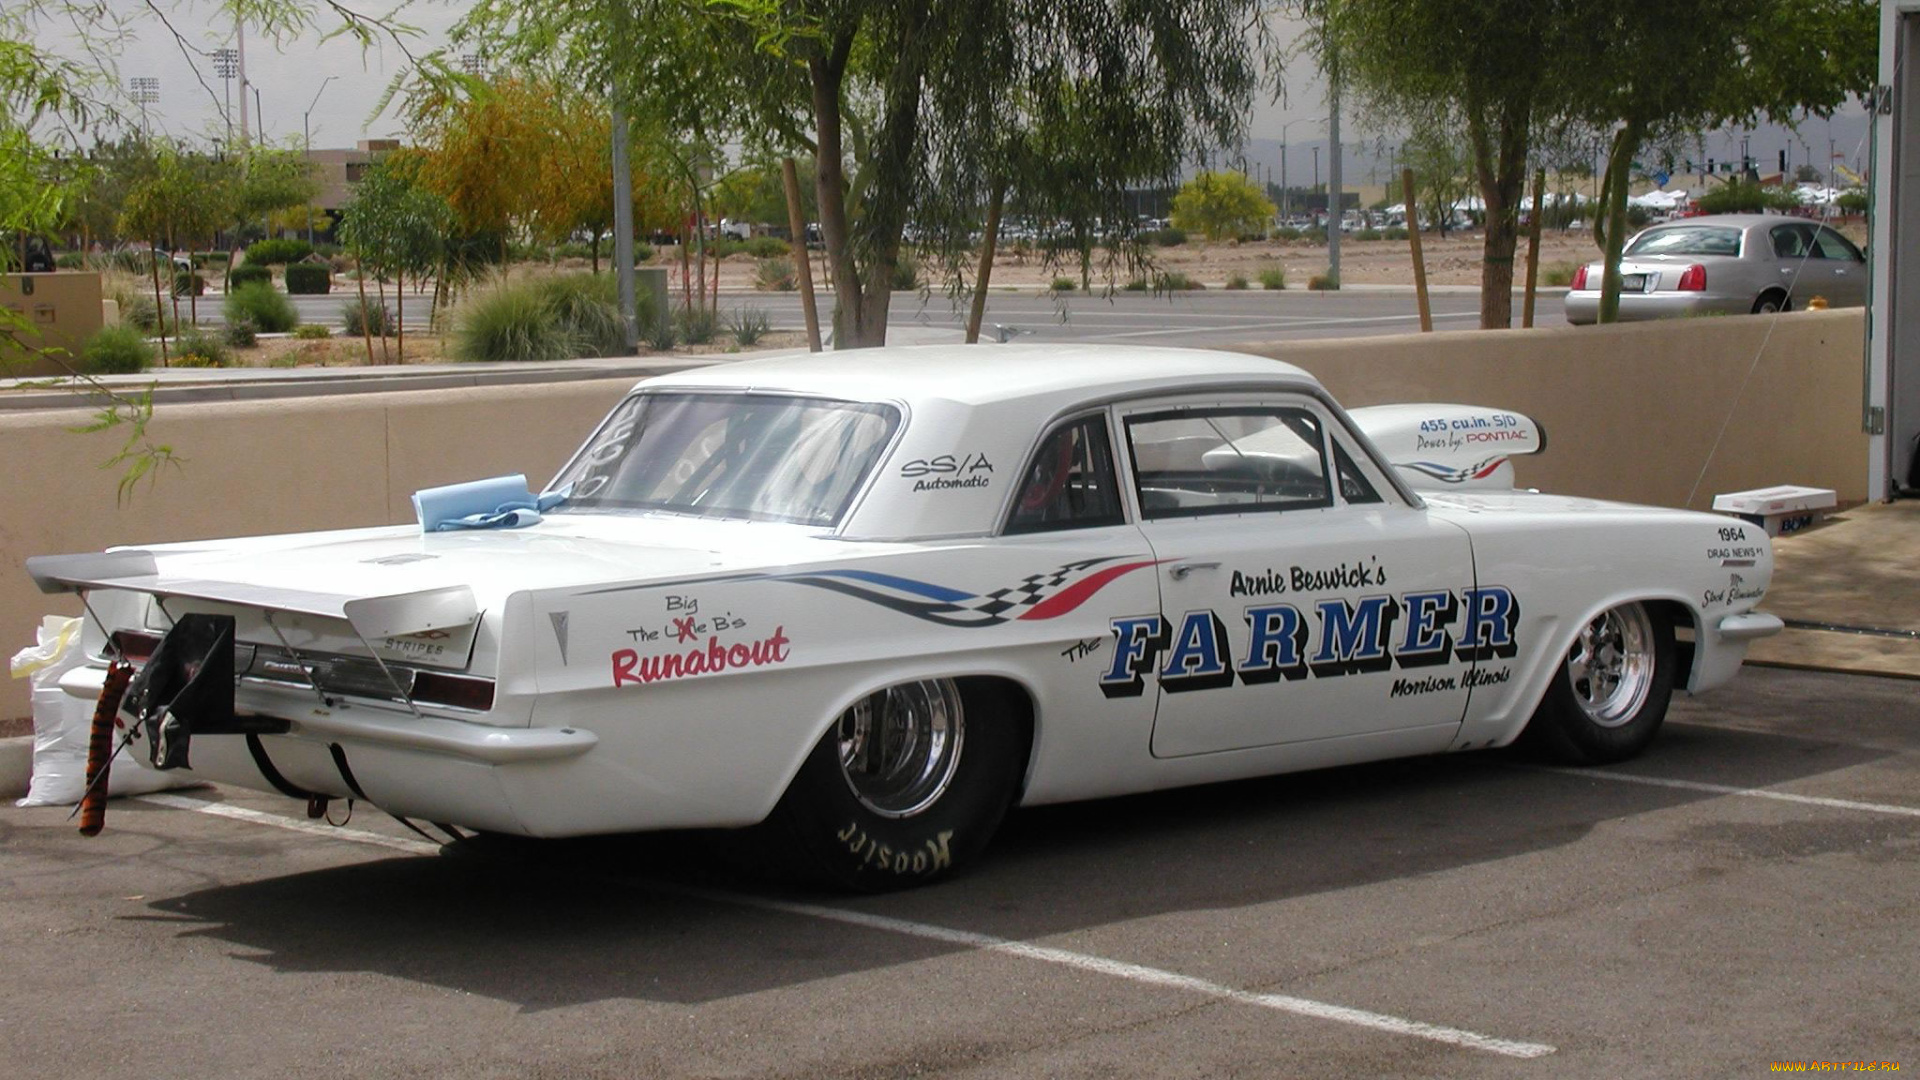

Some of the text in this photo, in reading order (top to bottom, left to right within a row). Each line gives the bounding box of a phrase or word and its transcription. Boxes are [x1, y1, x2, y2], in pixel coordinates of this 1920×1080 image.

[1421, 414, 1517, 432] 455 cu.in. S/D
[1466, 430, 1528, 443] PONTIAC
[901, 453, 993, 477] SS/A
[913, 475, 989, 492] Automatic
[1718, 527, 1746, 541] 1964
[1707, 548, 1731, 559] DRAG
[1732, 547, 1756, 558] NEWS
[1230, 555, 1387, 597] Arnie Beswick's
[665, 595, 698, 616] Big
[626, 626, 659, 642] The
[712, 611, 747, 631] B's
[384, 637, 444, 655] STRIPES
[1061, 585, 1520, 698] The FARMER
[612, 625, 790, 688] Runabout
[1460, 665, 1511, 689] Illinois
[837, 822, 953, 874] Hoosier
